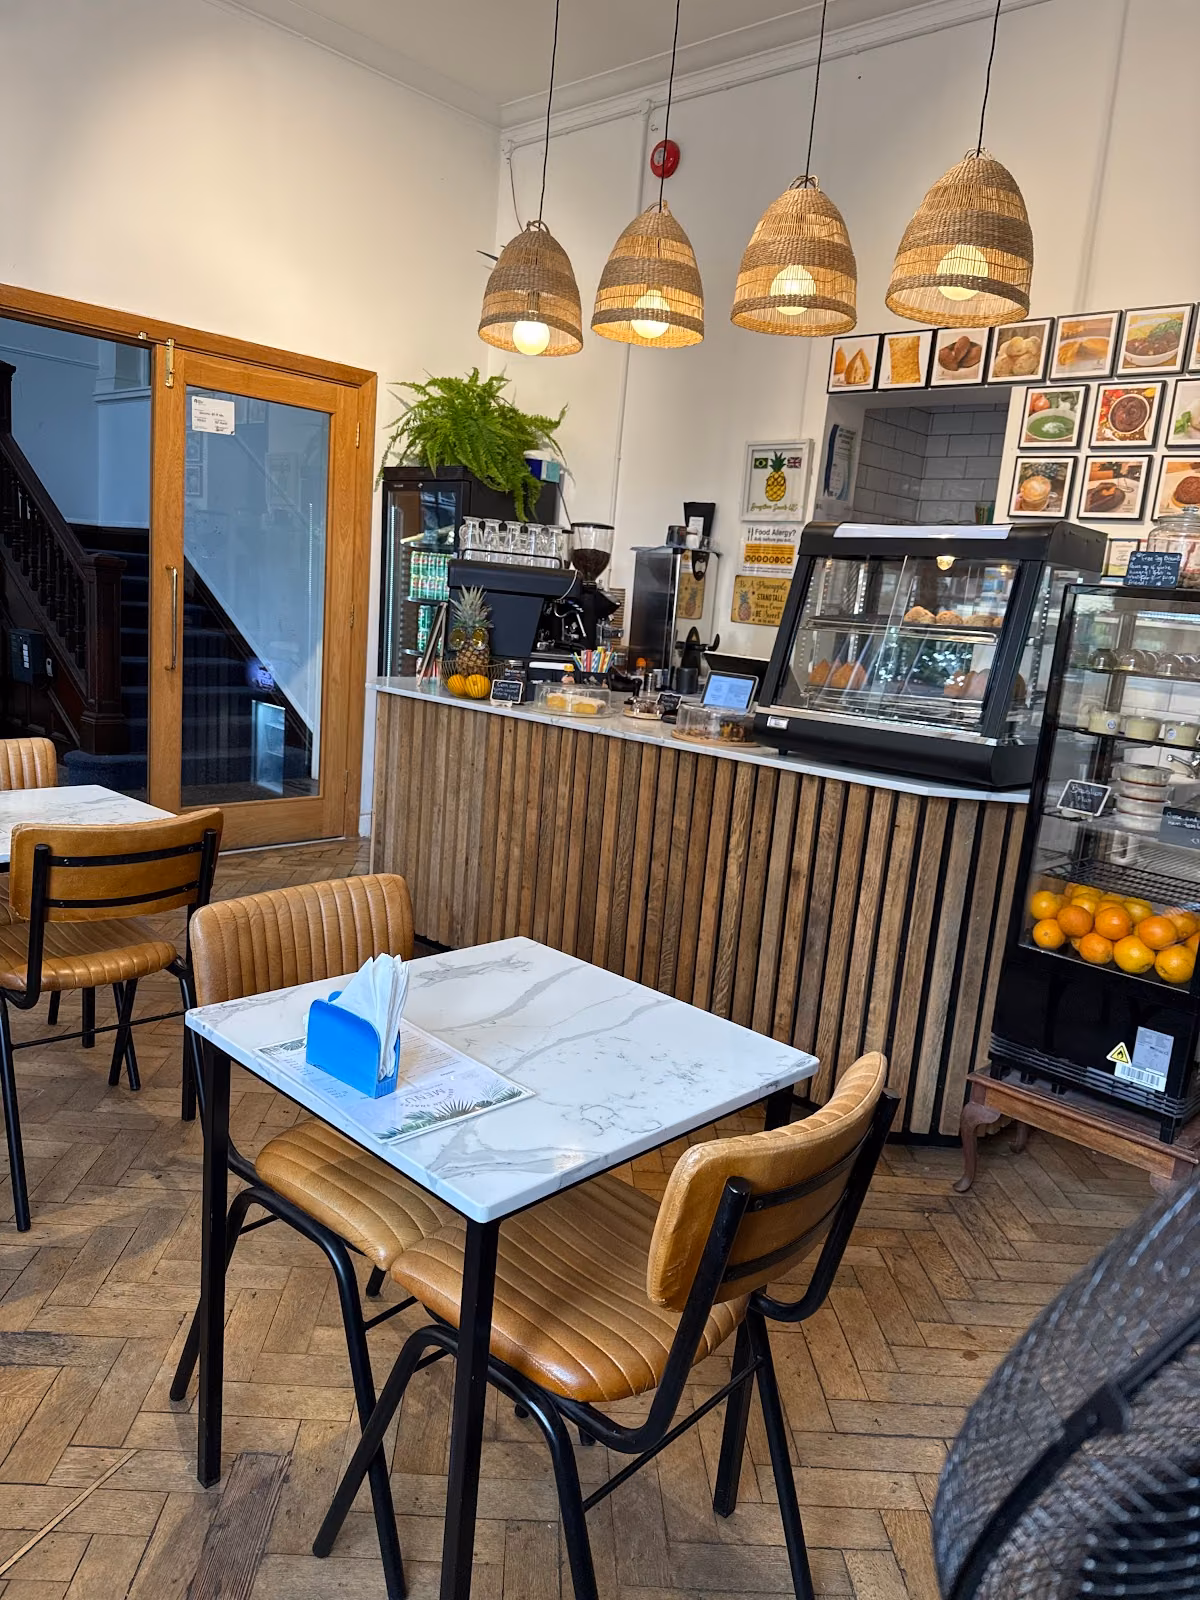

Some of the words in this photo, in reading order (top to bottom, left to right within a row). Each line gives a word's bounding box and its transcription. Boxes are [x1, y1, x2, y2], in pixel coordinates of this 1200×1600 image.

[755, 528, 770, 536] Food
[771, 528, 797, 538] Allergy?
[756, 593, 771, 602] STAND
[772, 594, 785, 603] TALL
[404, 1088, 447, 1104] MENU
